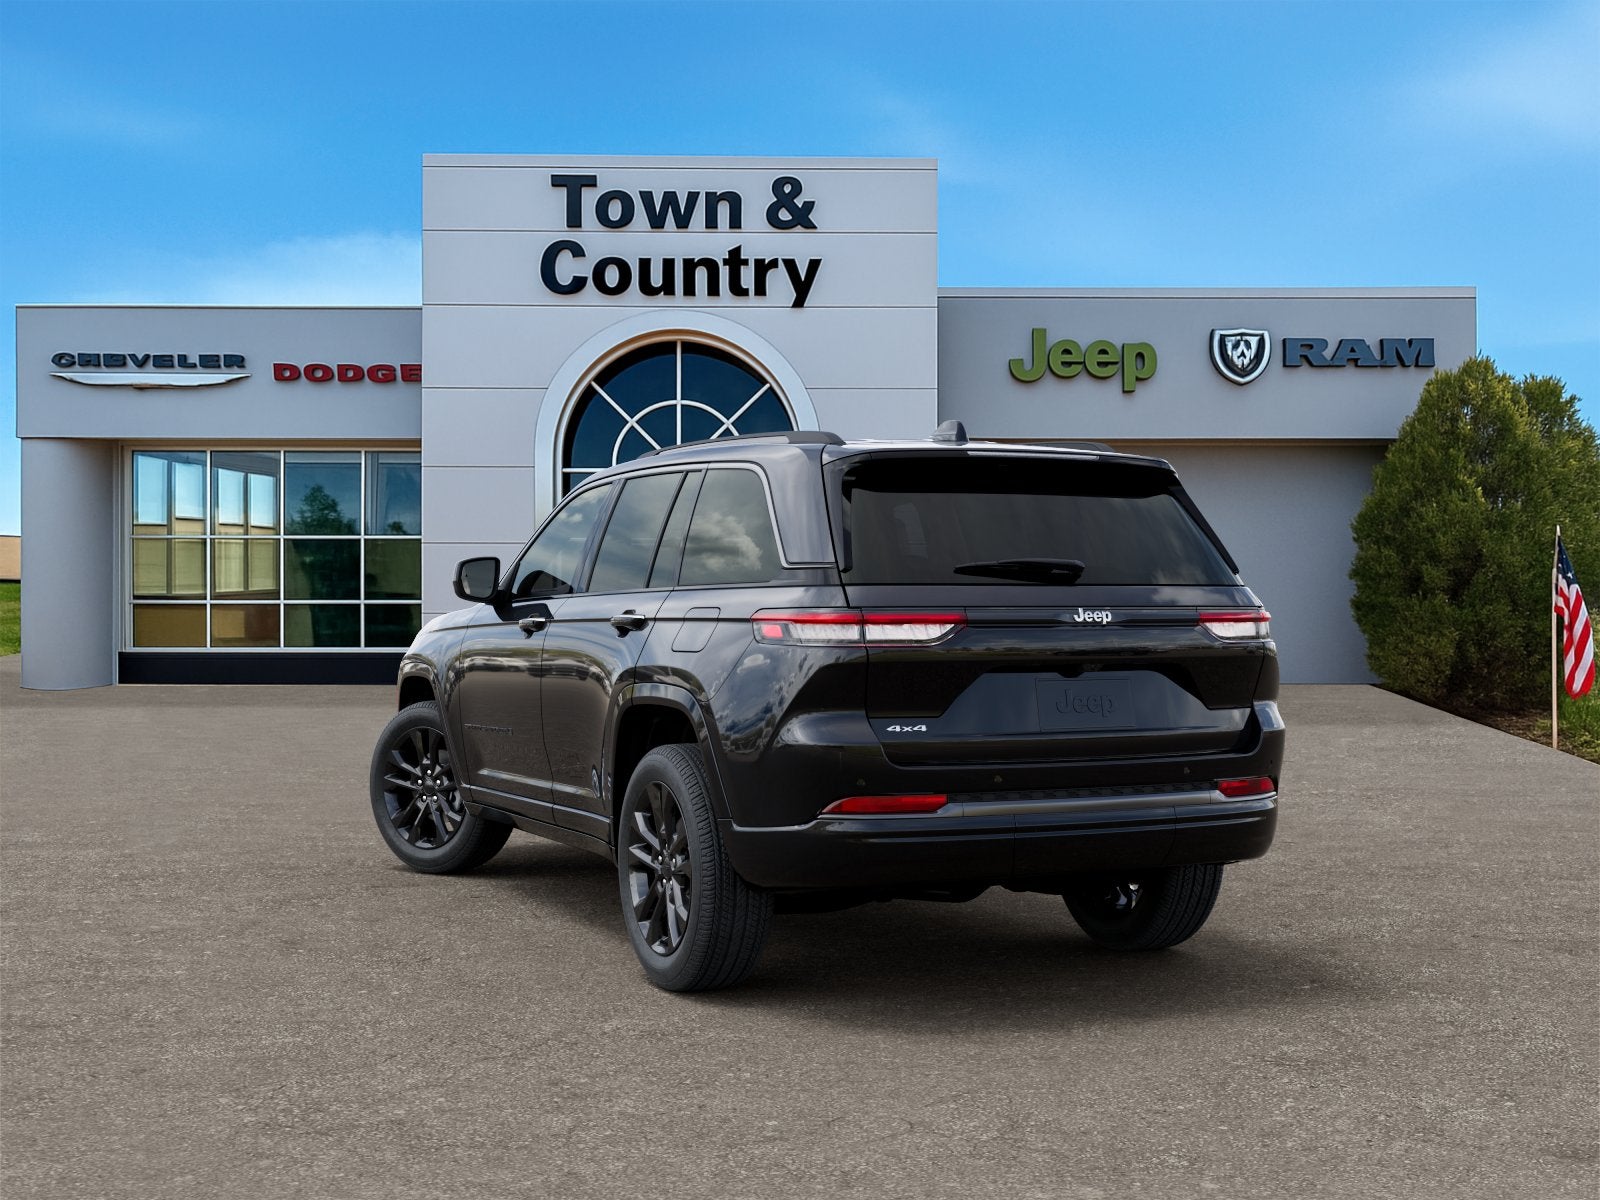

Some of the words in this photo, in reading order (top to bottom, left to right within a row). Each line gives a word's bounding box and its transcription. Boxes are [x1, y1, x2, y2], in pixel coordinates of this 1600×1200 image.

[551, 174, 742, 229] Town
[765, 176, 818, 230] &
[540, 239, 822, 308] Country
[1009, 328, 1158, 393] Jeep
[1283, 338, 1435, 368] RAM
[273, 363, 422, 383] DODGE
[1073, 608, 1112, 625] Jeep
[1056, 689, 1113, 718] Jeep
[886, 724, 927, 732] 4x4
